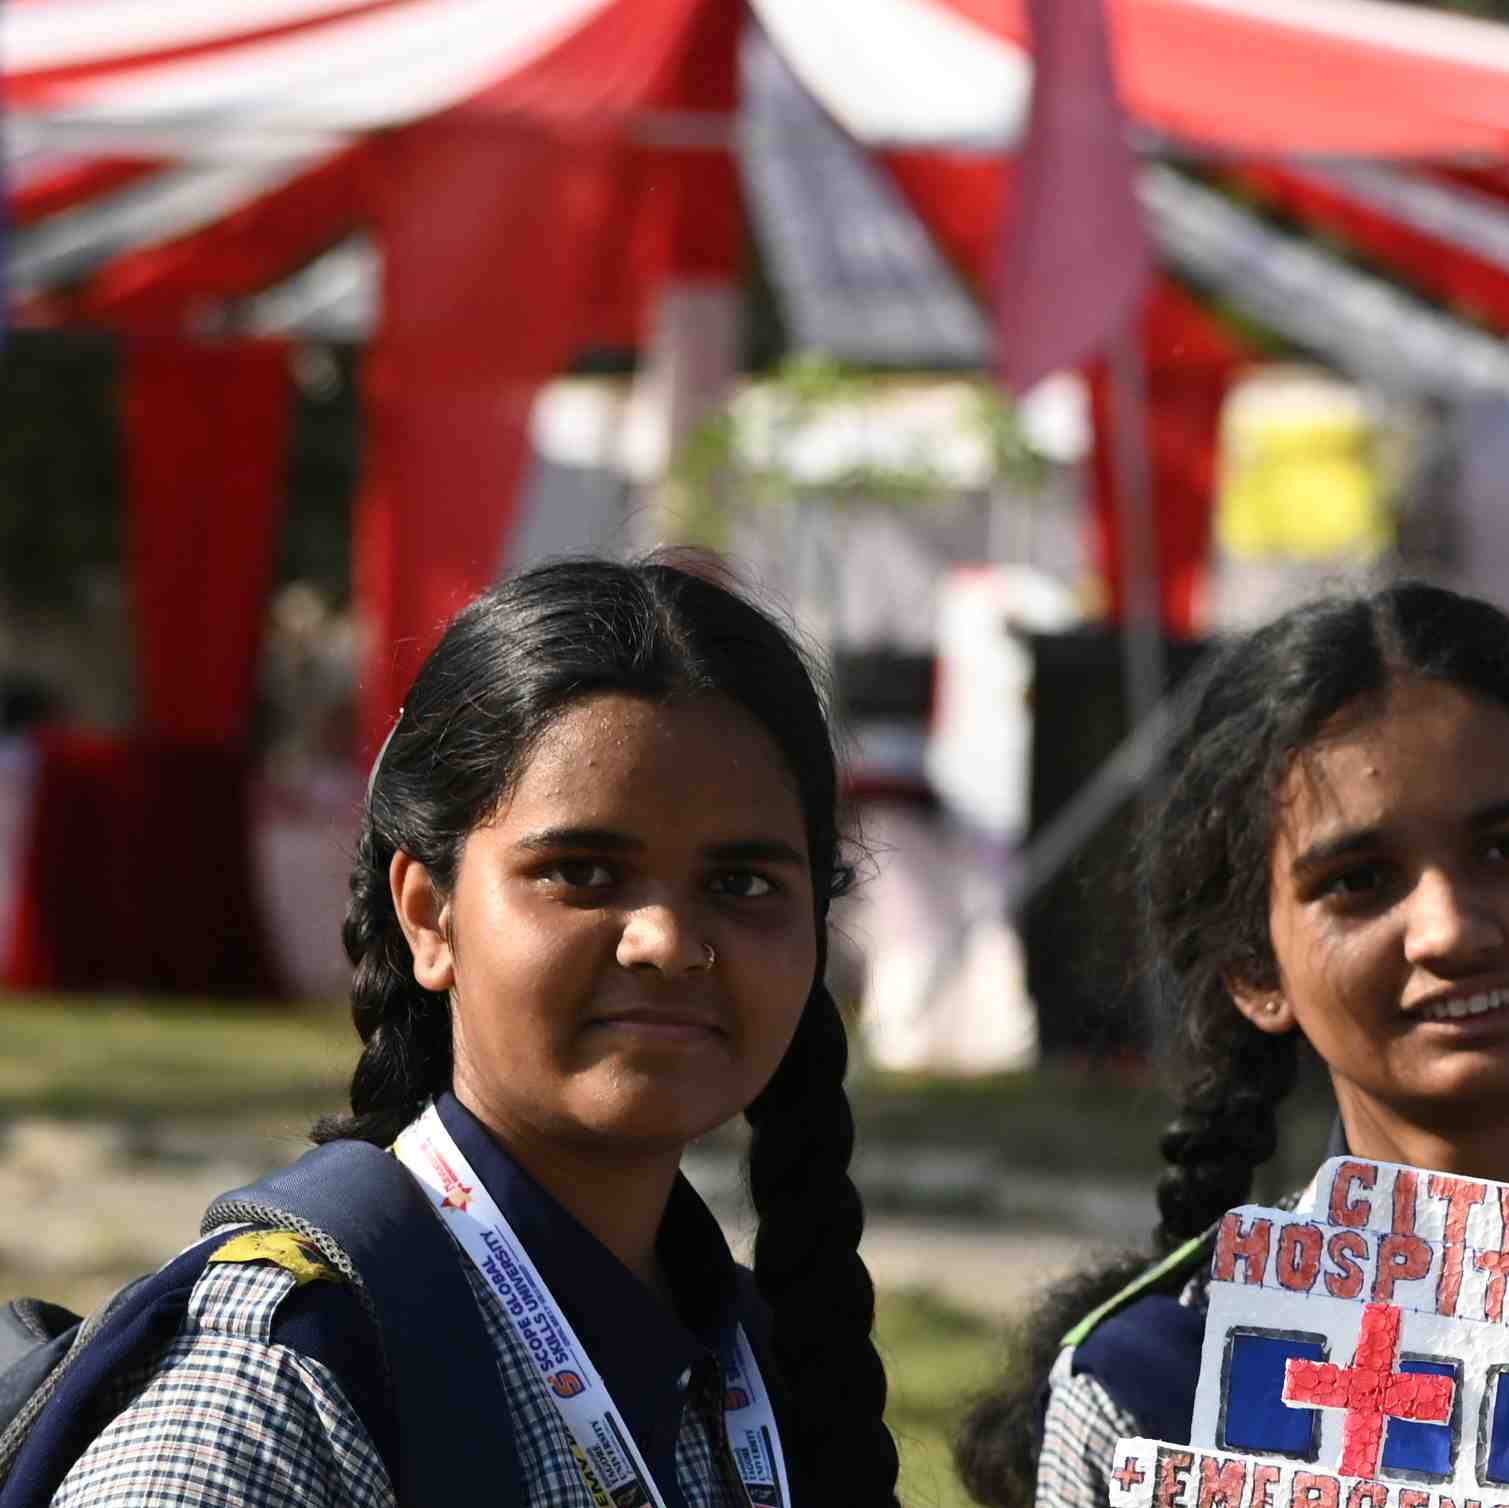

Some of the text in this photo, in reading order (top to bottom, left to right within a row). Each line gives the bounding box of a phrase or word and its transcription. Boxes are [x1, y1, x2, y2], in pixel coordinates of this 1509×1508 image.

[480, 1230, 539, 1312] UNIVERSITY
[481, 1255, 524, 1316] GLOBAL
[516, 1317, 555, 1373] SCOPE
[533, 1312, 569, 1364] SKILLS
